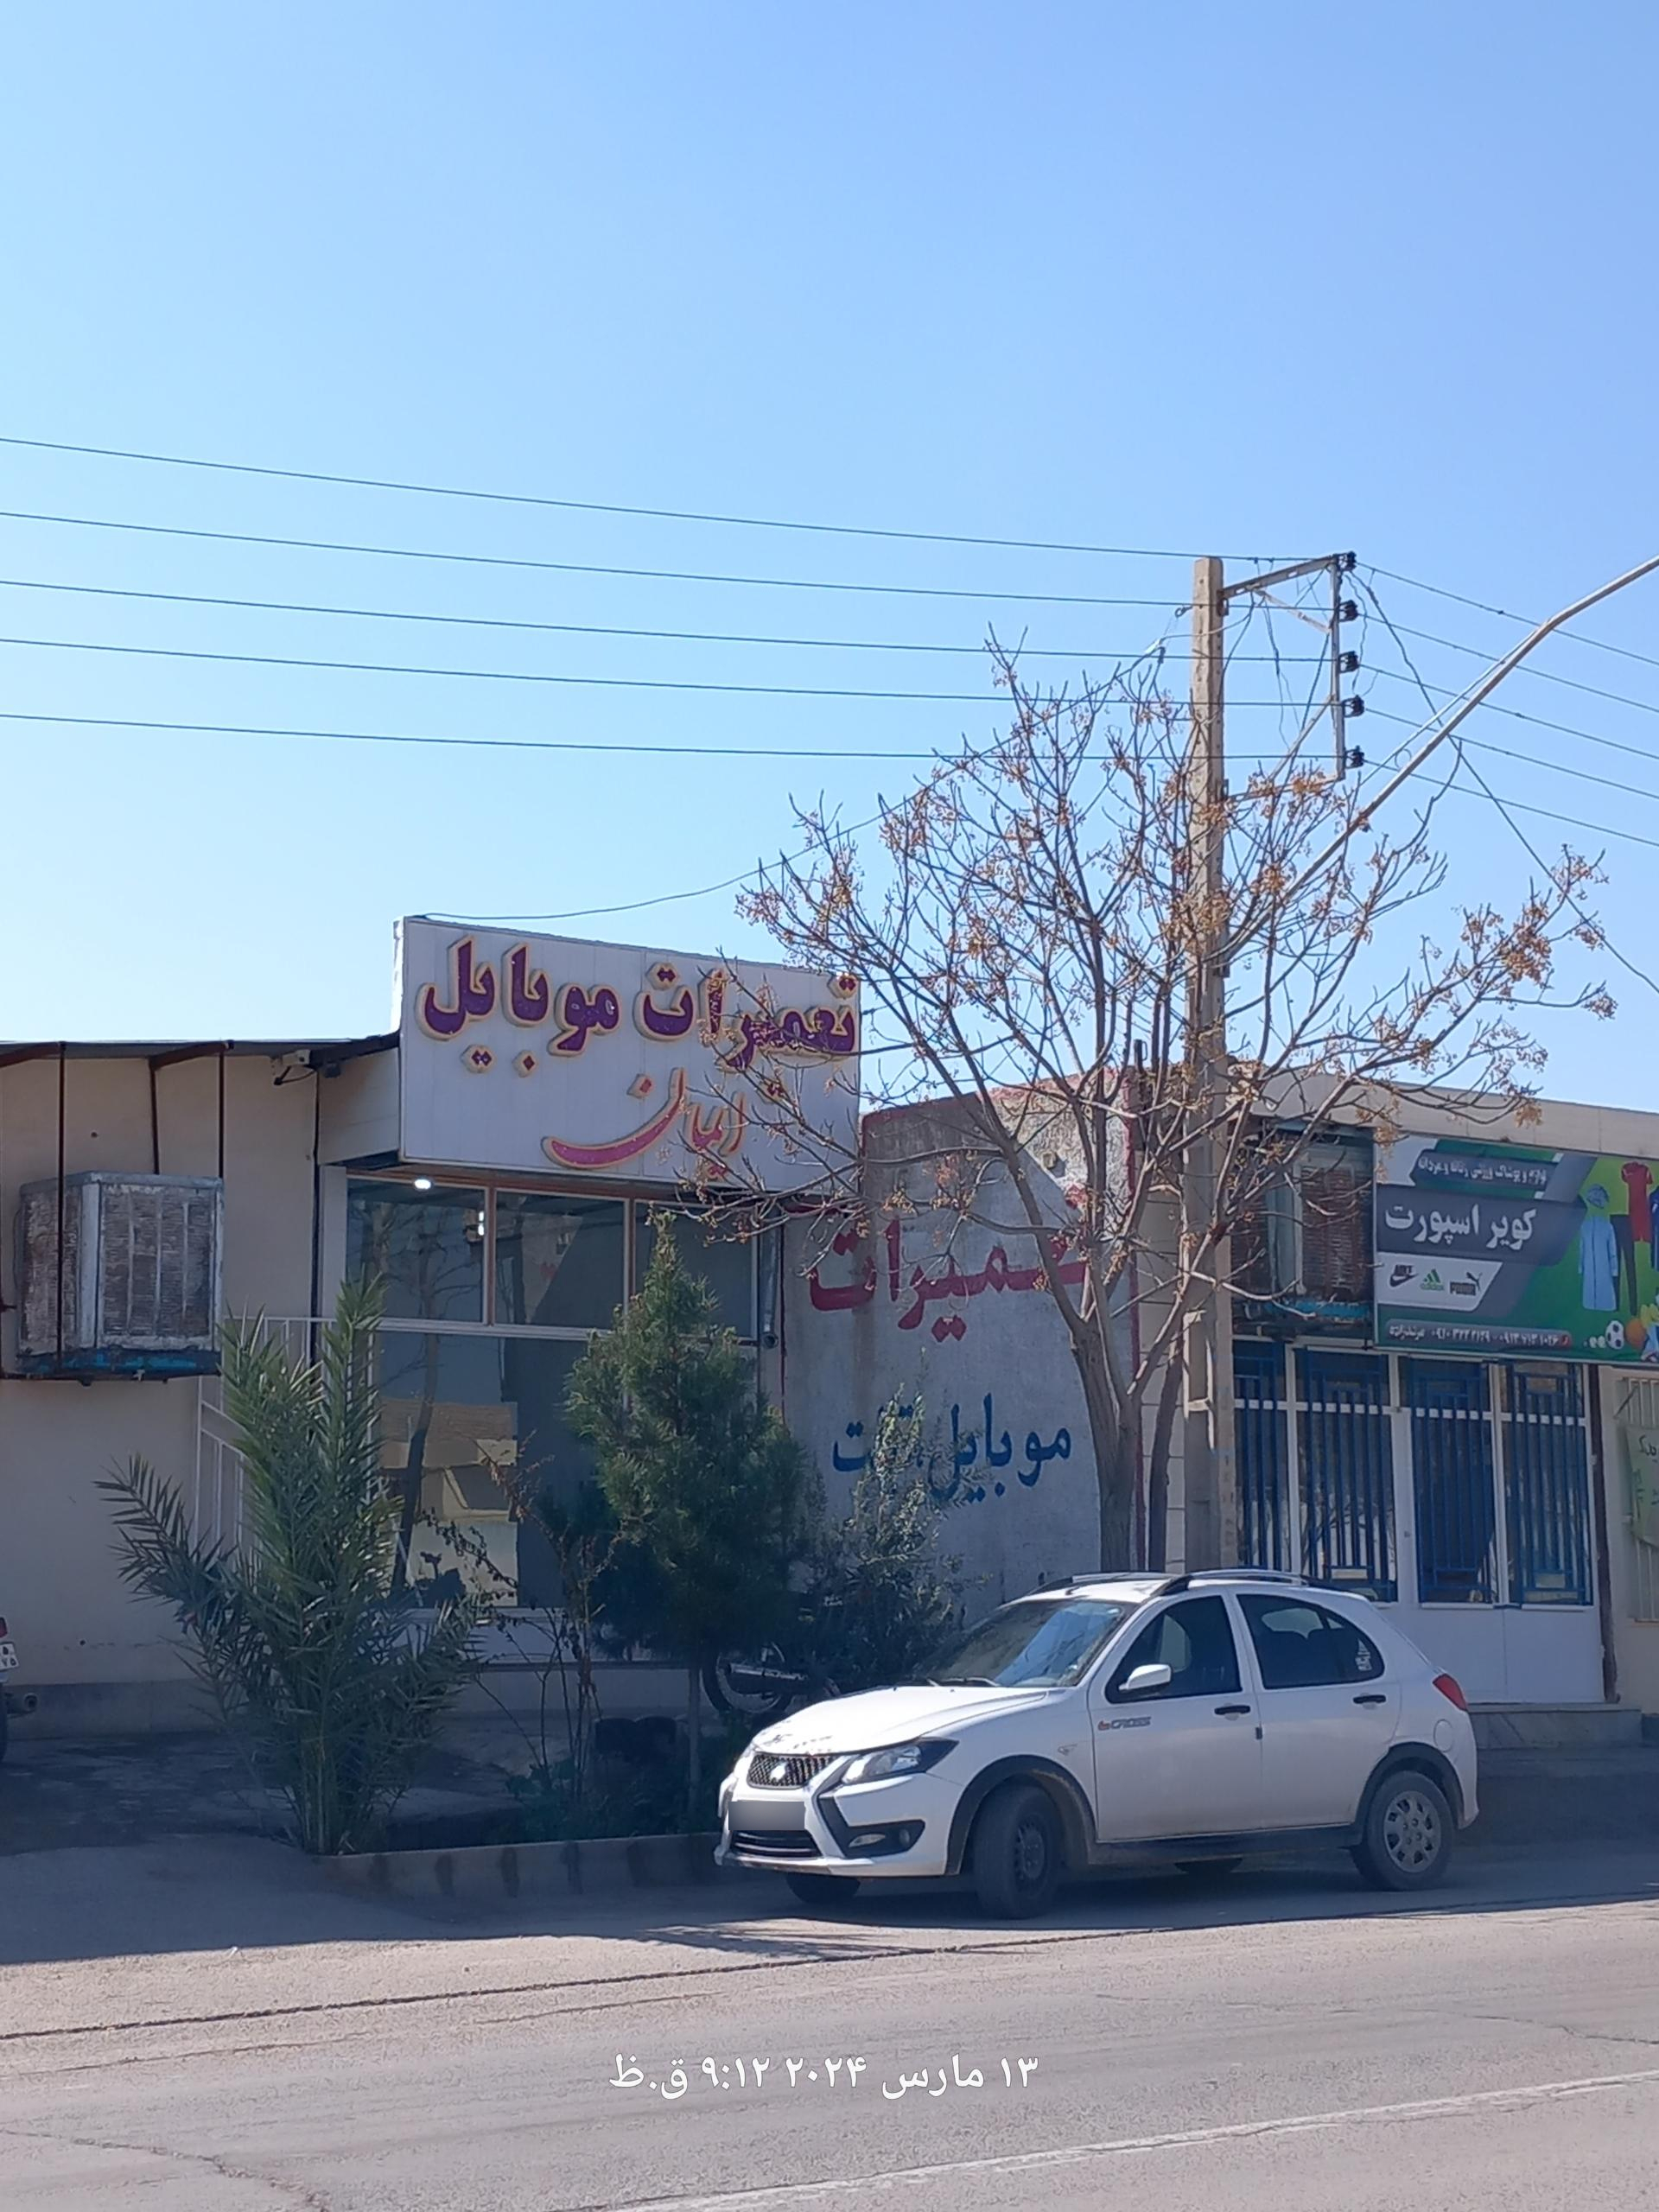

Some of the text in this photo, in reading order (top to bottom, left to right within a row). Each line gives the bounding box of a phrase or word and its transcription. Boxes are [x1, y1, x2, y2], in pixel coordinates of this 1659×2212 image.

[416, 936, 859, 1104] تعمیرات موبایل
[1385, 1203, 1537, 1250] کویر اسپورت
[927, 1392, 1072, 1504] موبایل
